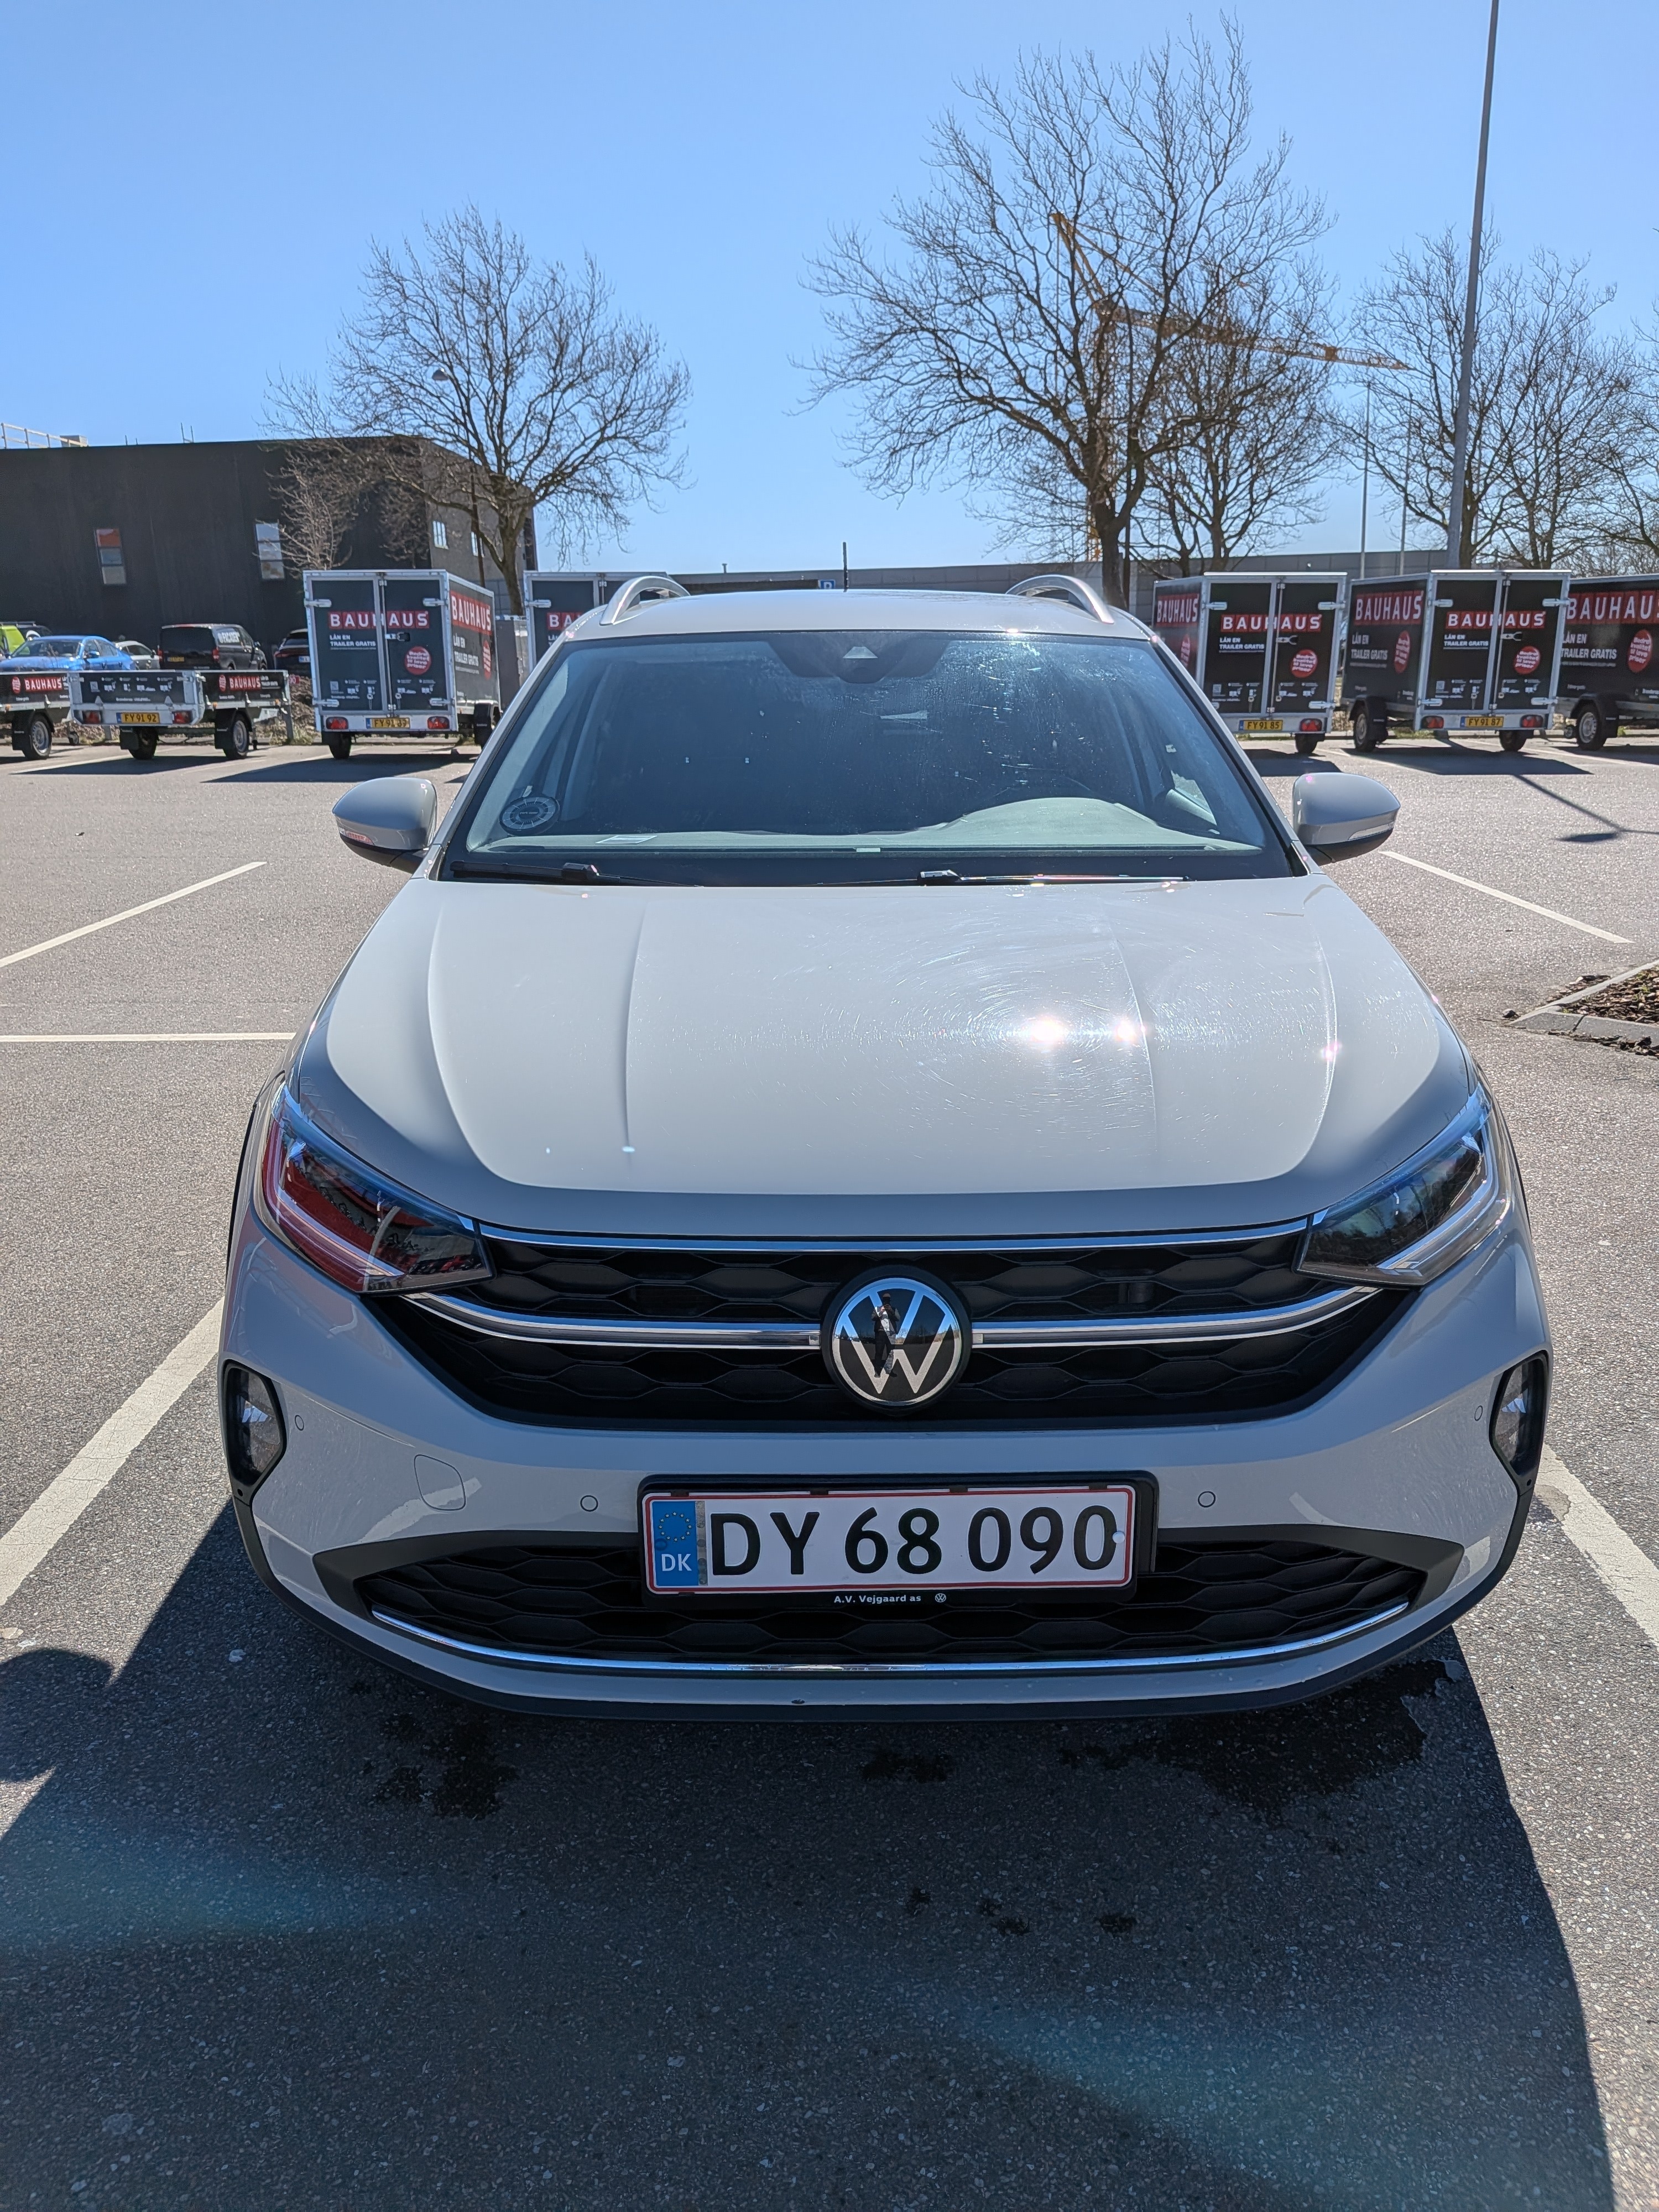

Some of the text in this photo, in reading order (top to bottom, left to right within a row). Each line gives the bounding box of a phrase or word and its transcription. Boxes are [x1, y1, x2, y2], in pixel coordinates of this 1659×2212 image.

[451, 596, 491, 631] BAUHAUS
[1157, 598, 1198, 623] BAUHAUS
[1355, 595, 1422, 620] BAUHAUS
[330, 613, 427, 627] BAUHAUS
[1223, 616, 1321, 630] BAUHAUS
[1448, 613, 1544, 627] BAUHAUS
[1562, 631, 1587, 644] LÅN EN
[1561, 648, 1618, 659] TRAILER GRATIS
[24, 677, 62, 690] BAUHAUS
[229, 677, 260, 688] BAUHAUS
[136, 714, 145, 722] 91
[147, 714, 156, 722] 92
[710, 1505, 1118, 1575] DY 68 090
[661, 1553, 692, 1571] DK
[859, 1595, 906, 1604] Vejgaard
